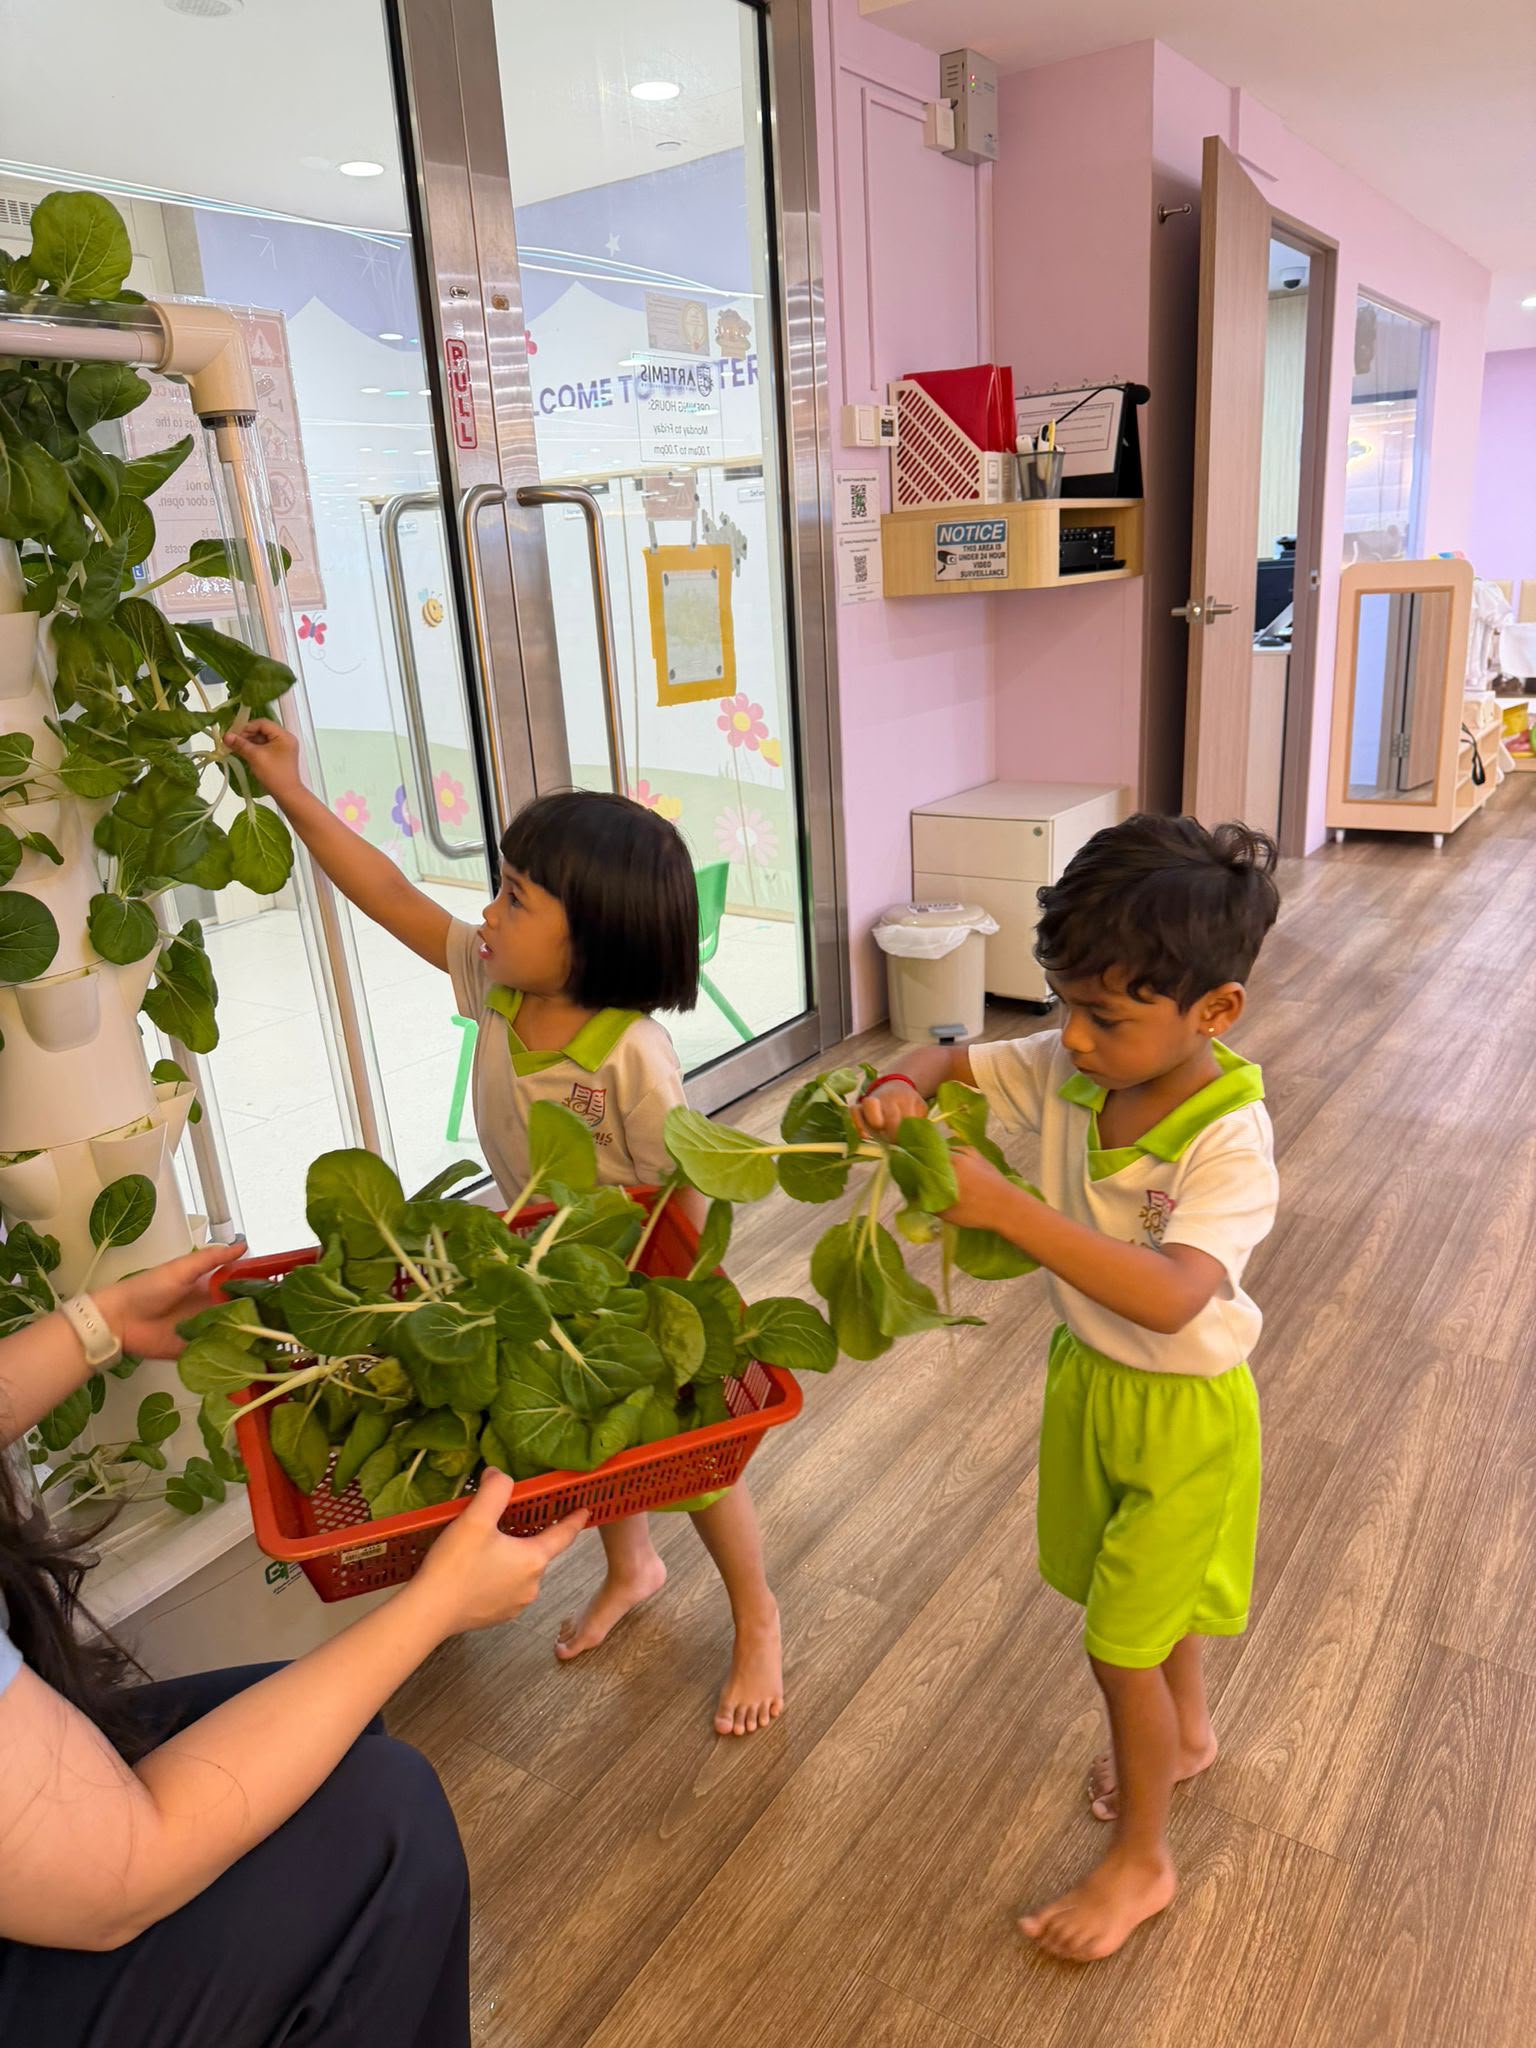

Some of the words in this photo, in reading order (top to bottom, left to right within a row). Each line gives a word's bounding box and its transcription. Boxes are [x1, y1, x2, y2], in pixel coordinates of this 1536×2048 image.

[452, 346, 473, 443] PULL
[533, 377, 613, 416] COME
[939, 523, 1005, 543] NOTICE
[959, 553, 979, 561] UNDER
[980, 552, 988, 560] 24
[960, 568, 1005, 577] SURVEILLANCE
